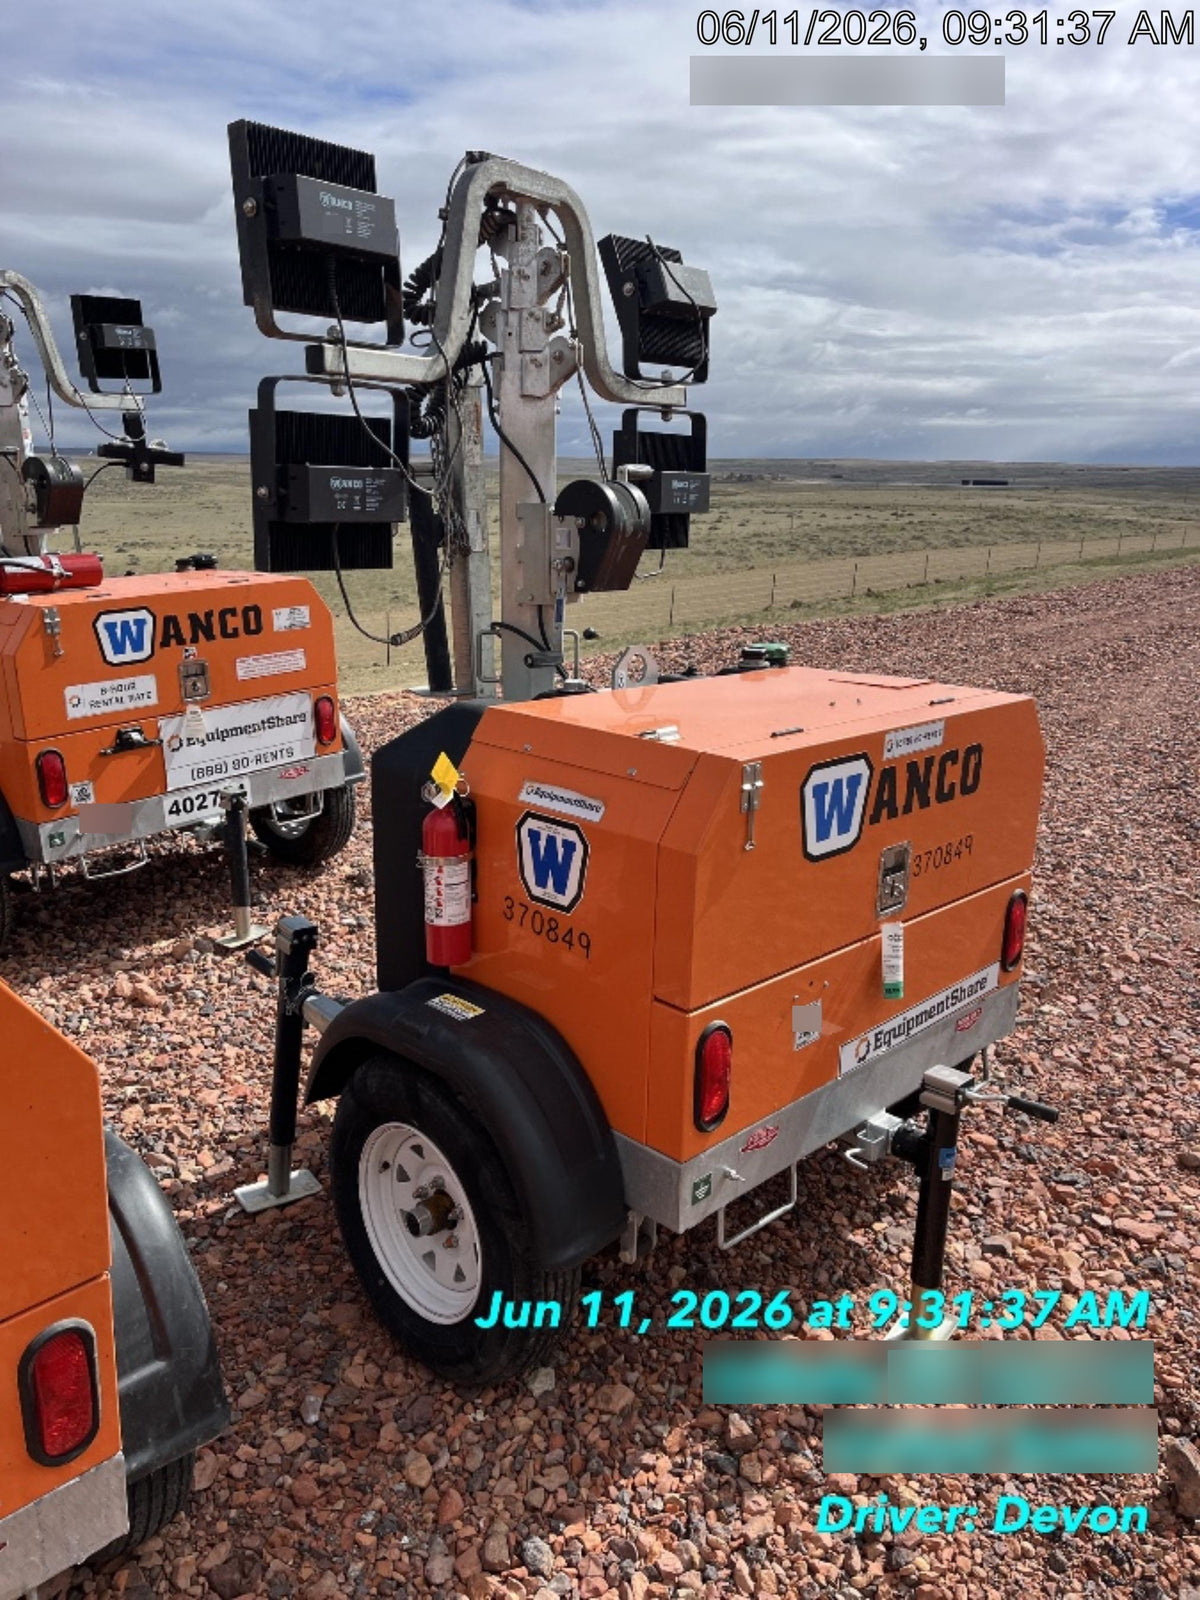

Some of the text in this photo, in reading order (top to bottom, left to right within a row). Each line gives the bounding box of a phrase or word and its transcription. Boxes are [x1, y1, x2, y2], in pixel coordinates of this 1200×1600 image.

[103, 604, 263, 655] WANCO
[812, 743, 983, 843] WANCO
[528, 827, 577, 897] W
[912, 834, 974, 877] 370849
[503, 896, 592, 959] 370849
[873, 976, 988, 1051] EquipmentShare
